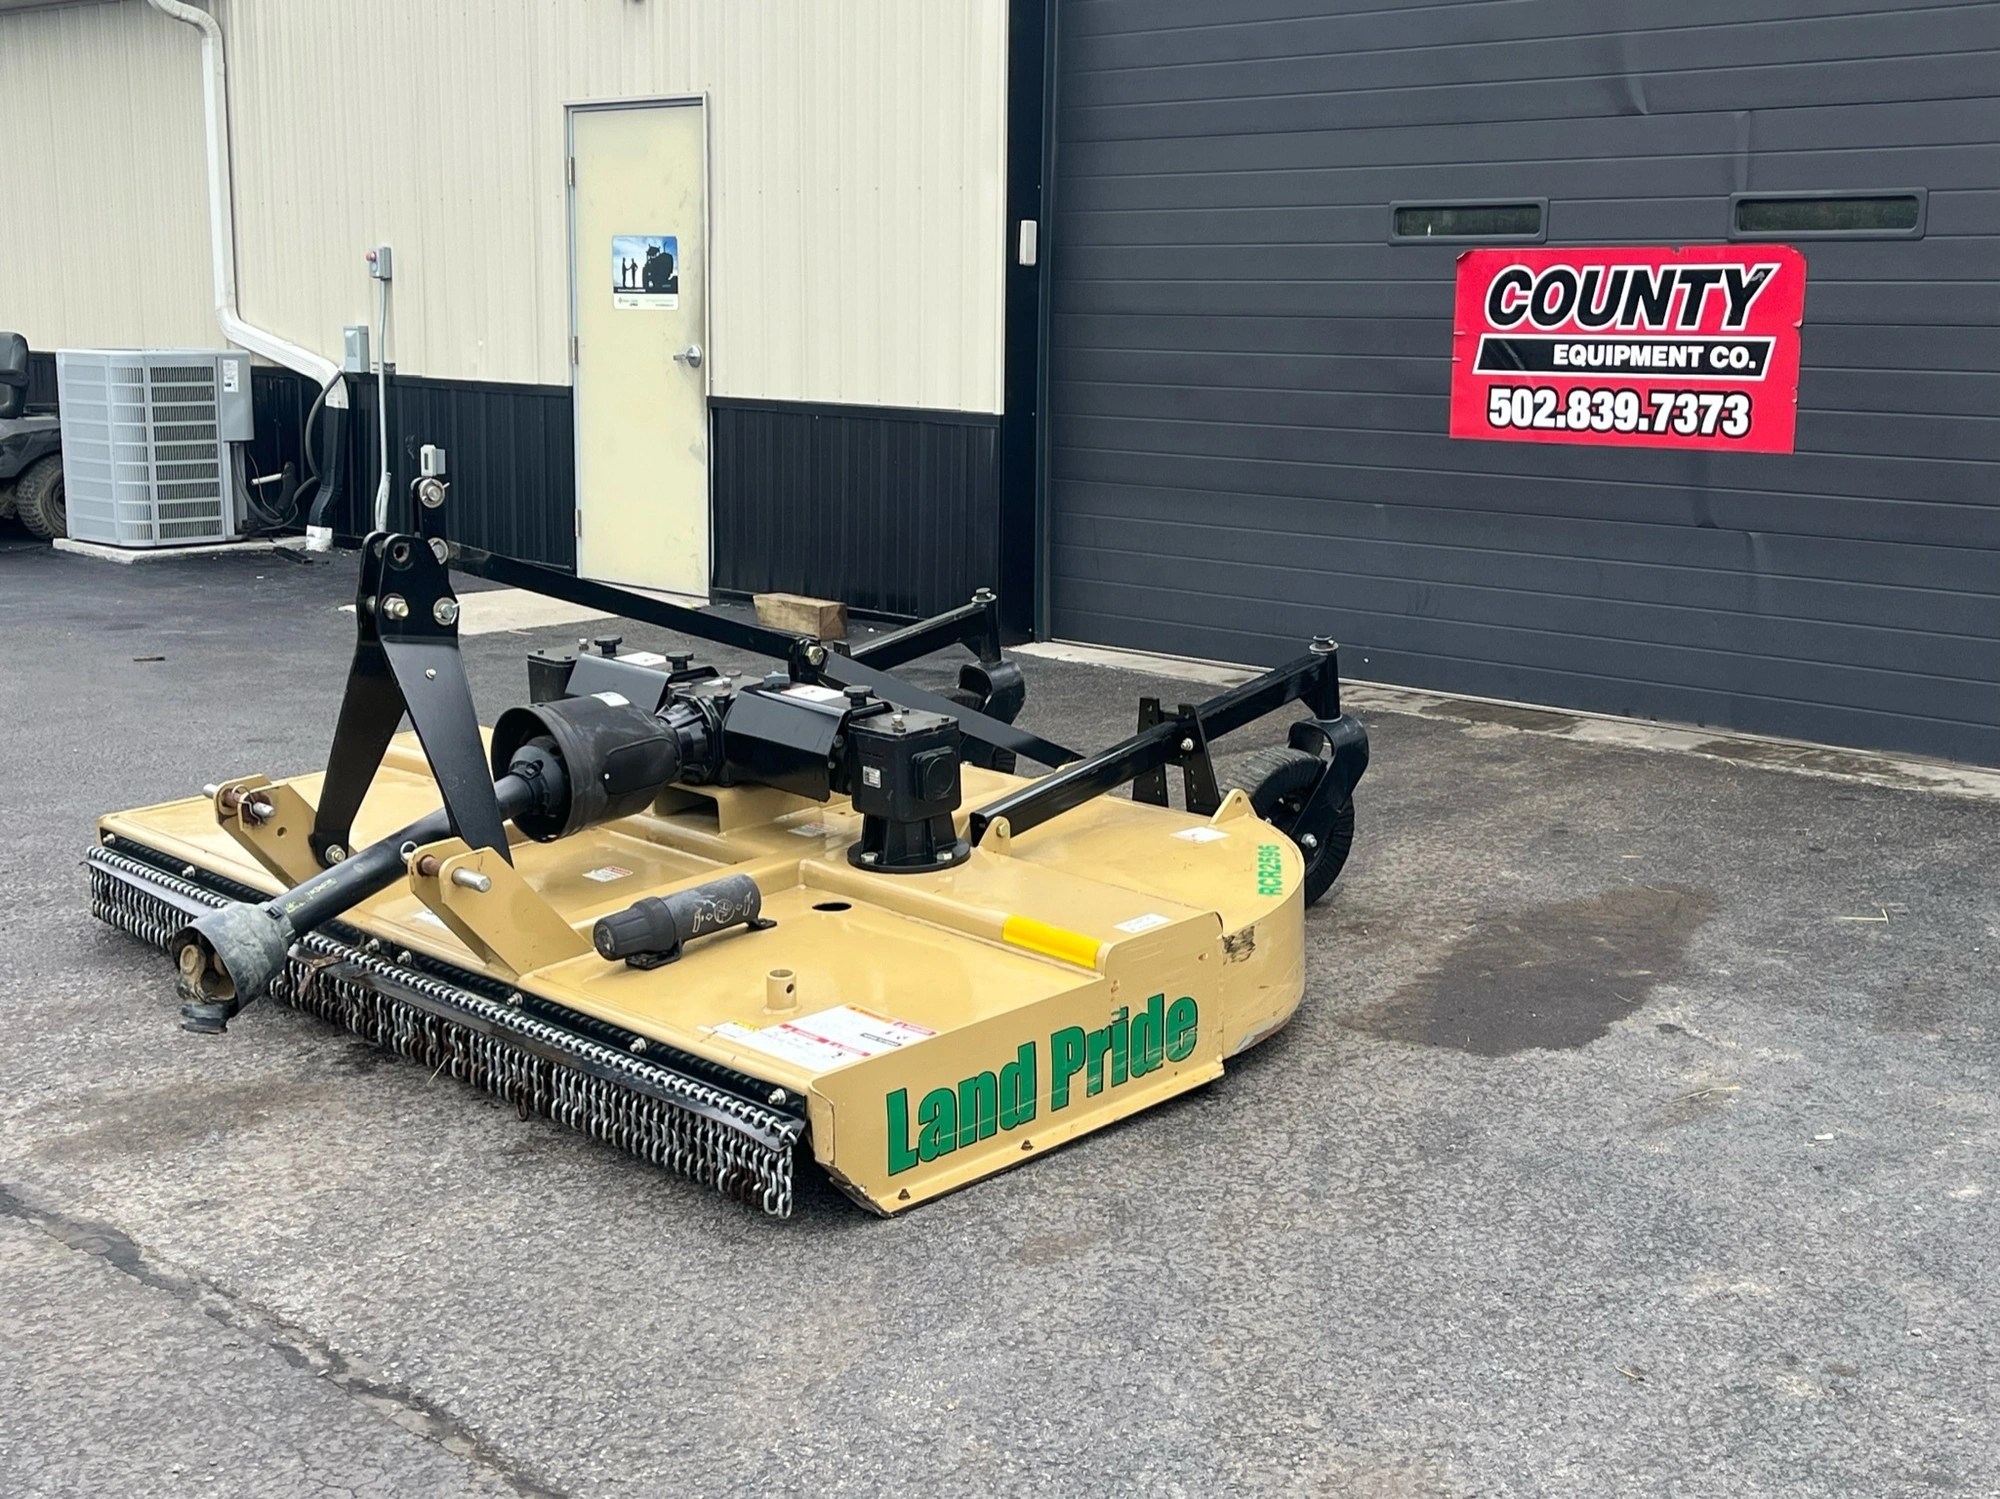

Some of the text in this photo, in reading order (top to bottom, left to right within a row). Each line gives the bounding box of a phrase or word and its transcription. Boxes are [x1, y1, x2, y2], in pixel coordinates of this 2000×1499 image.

[1485, 263, 1781, 331] COUNTY
[1553, 344, 1757, 369] EQUIPMENT CO.
[1488, 386, 1751, 437] 502.839.7373
[1257, 845, 1283, 896] RCR2596
[886, 993, 1198, 1177] Land Pride
